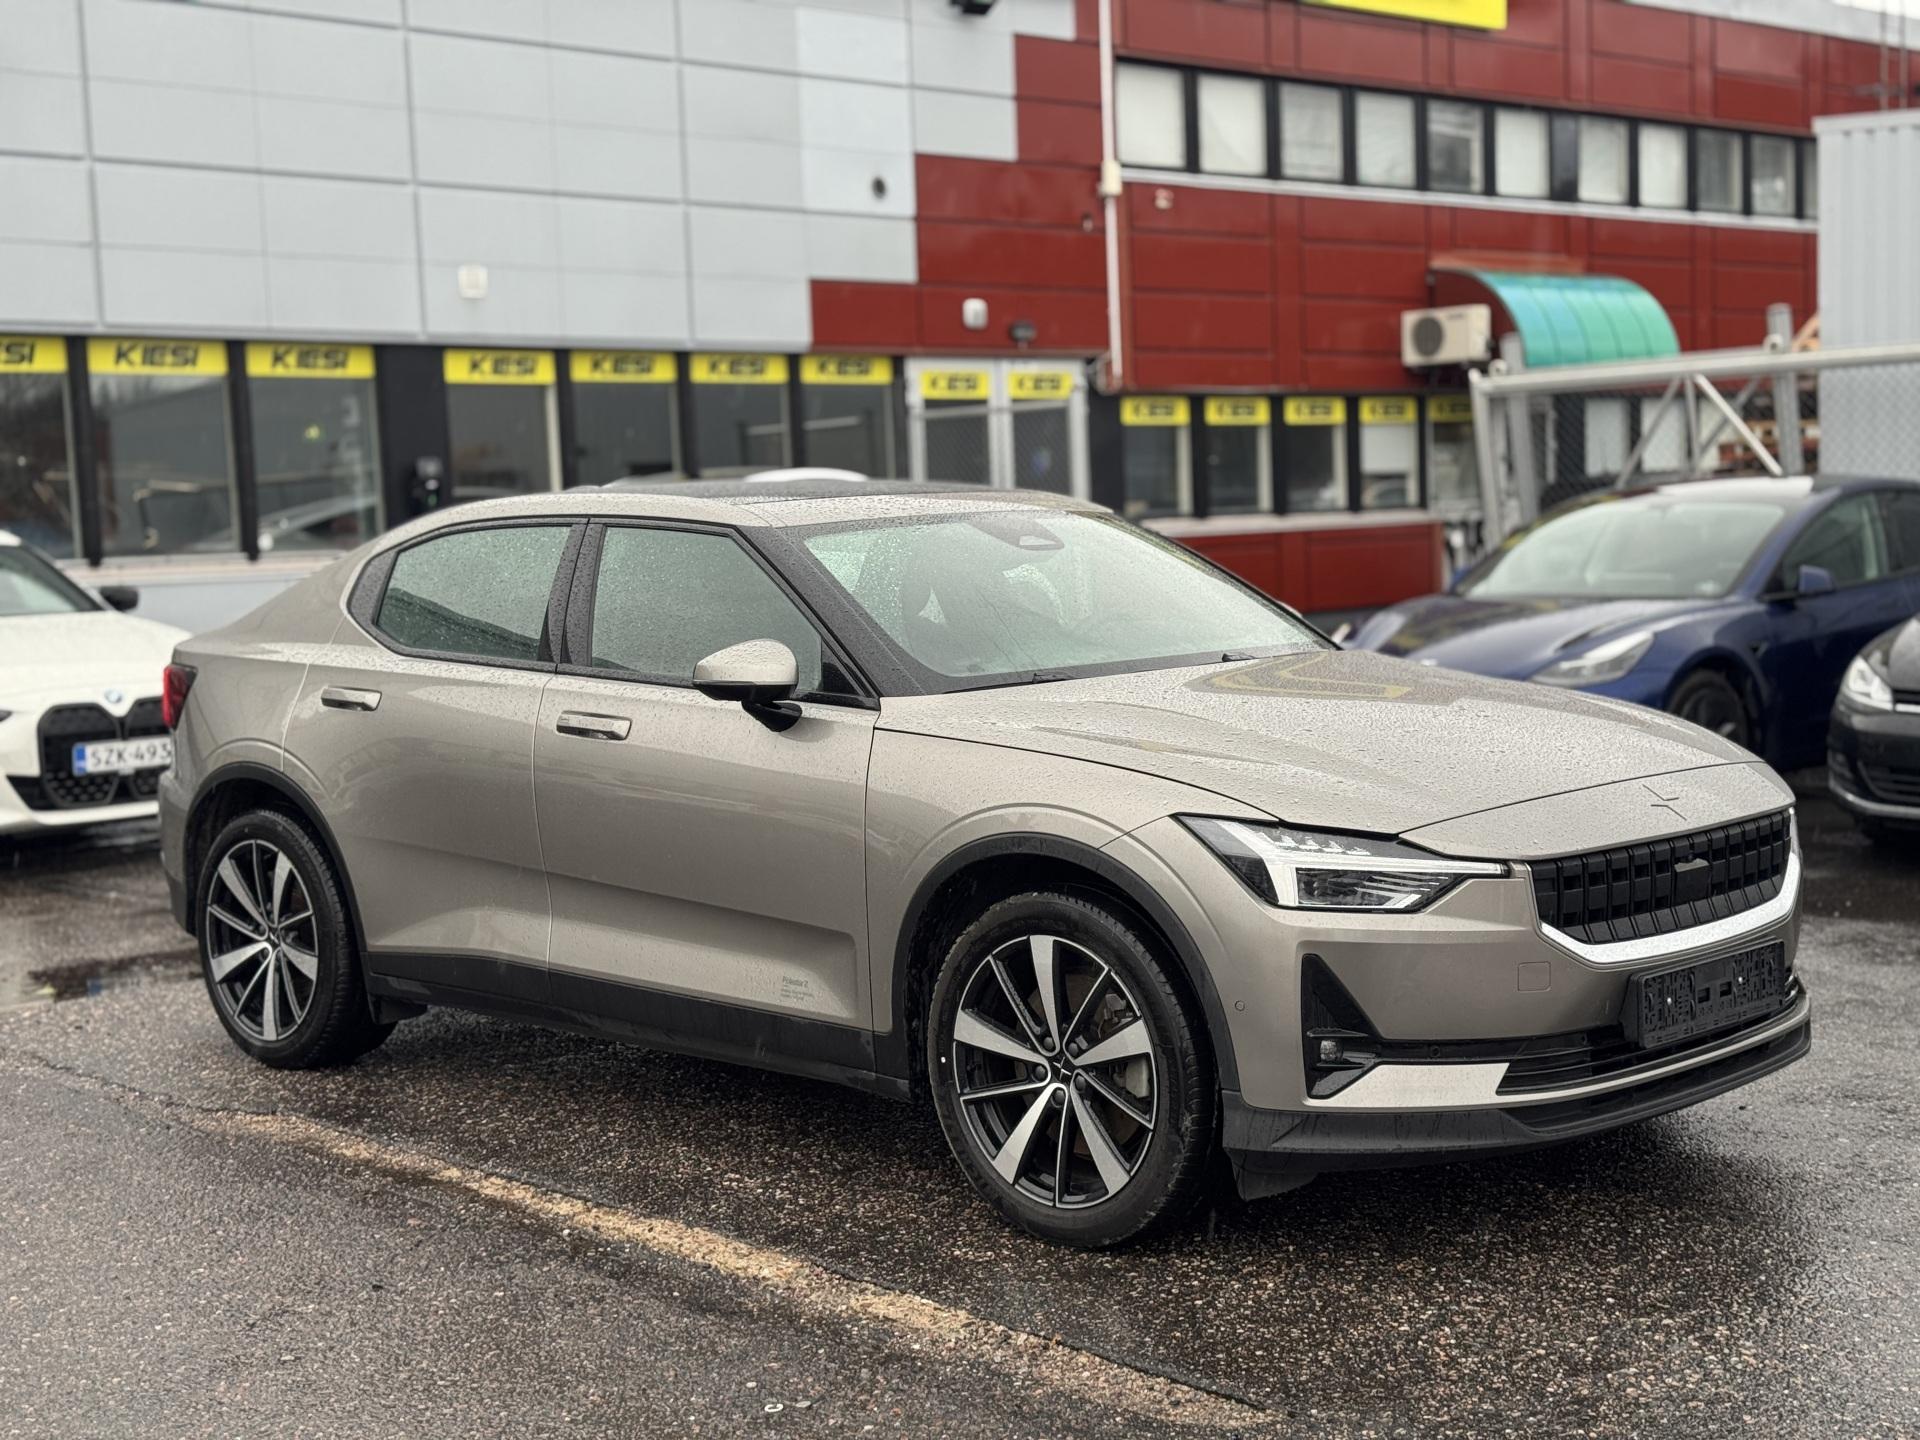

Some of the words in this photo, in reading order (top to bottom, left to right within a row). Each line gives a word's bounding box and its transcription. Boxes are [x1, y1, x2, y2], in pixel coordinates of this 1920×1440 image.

[114, 342, 199, 367] KIESI
[270, 346, 349, 369] KIESI
[468, 355, 540, 376] KIESI
